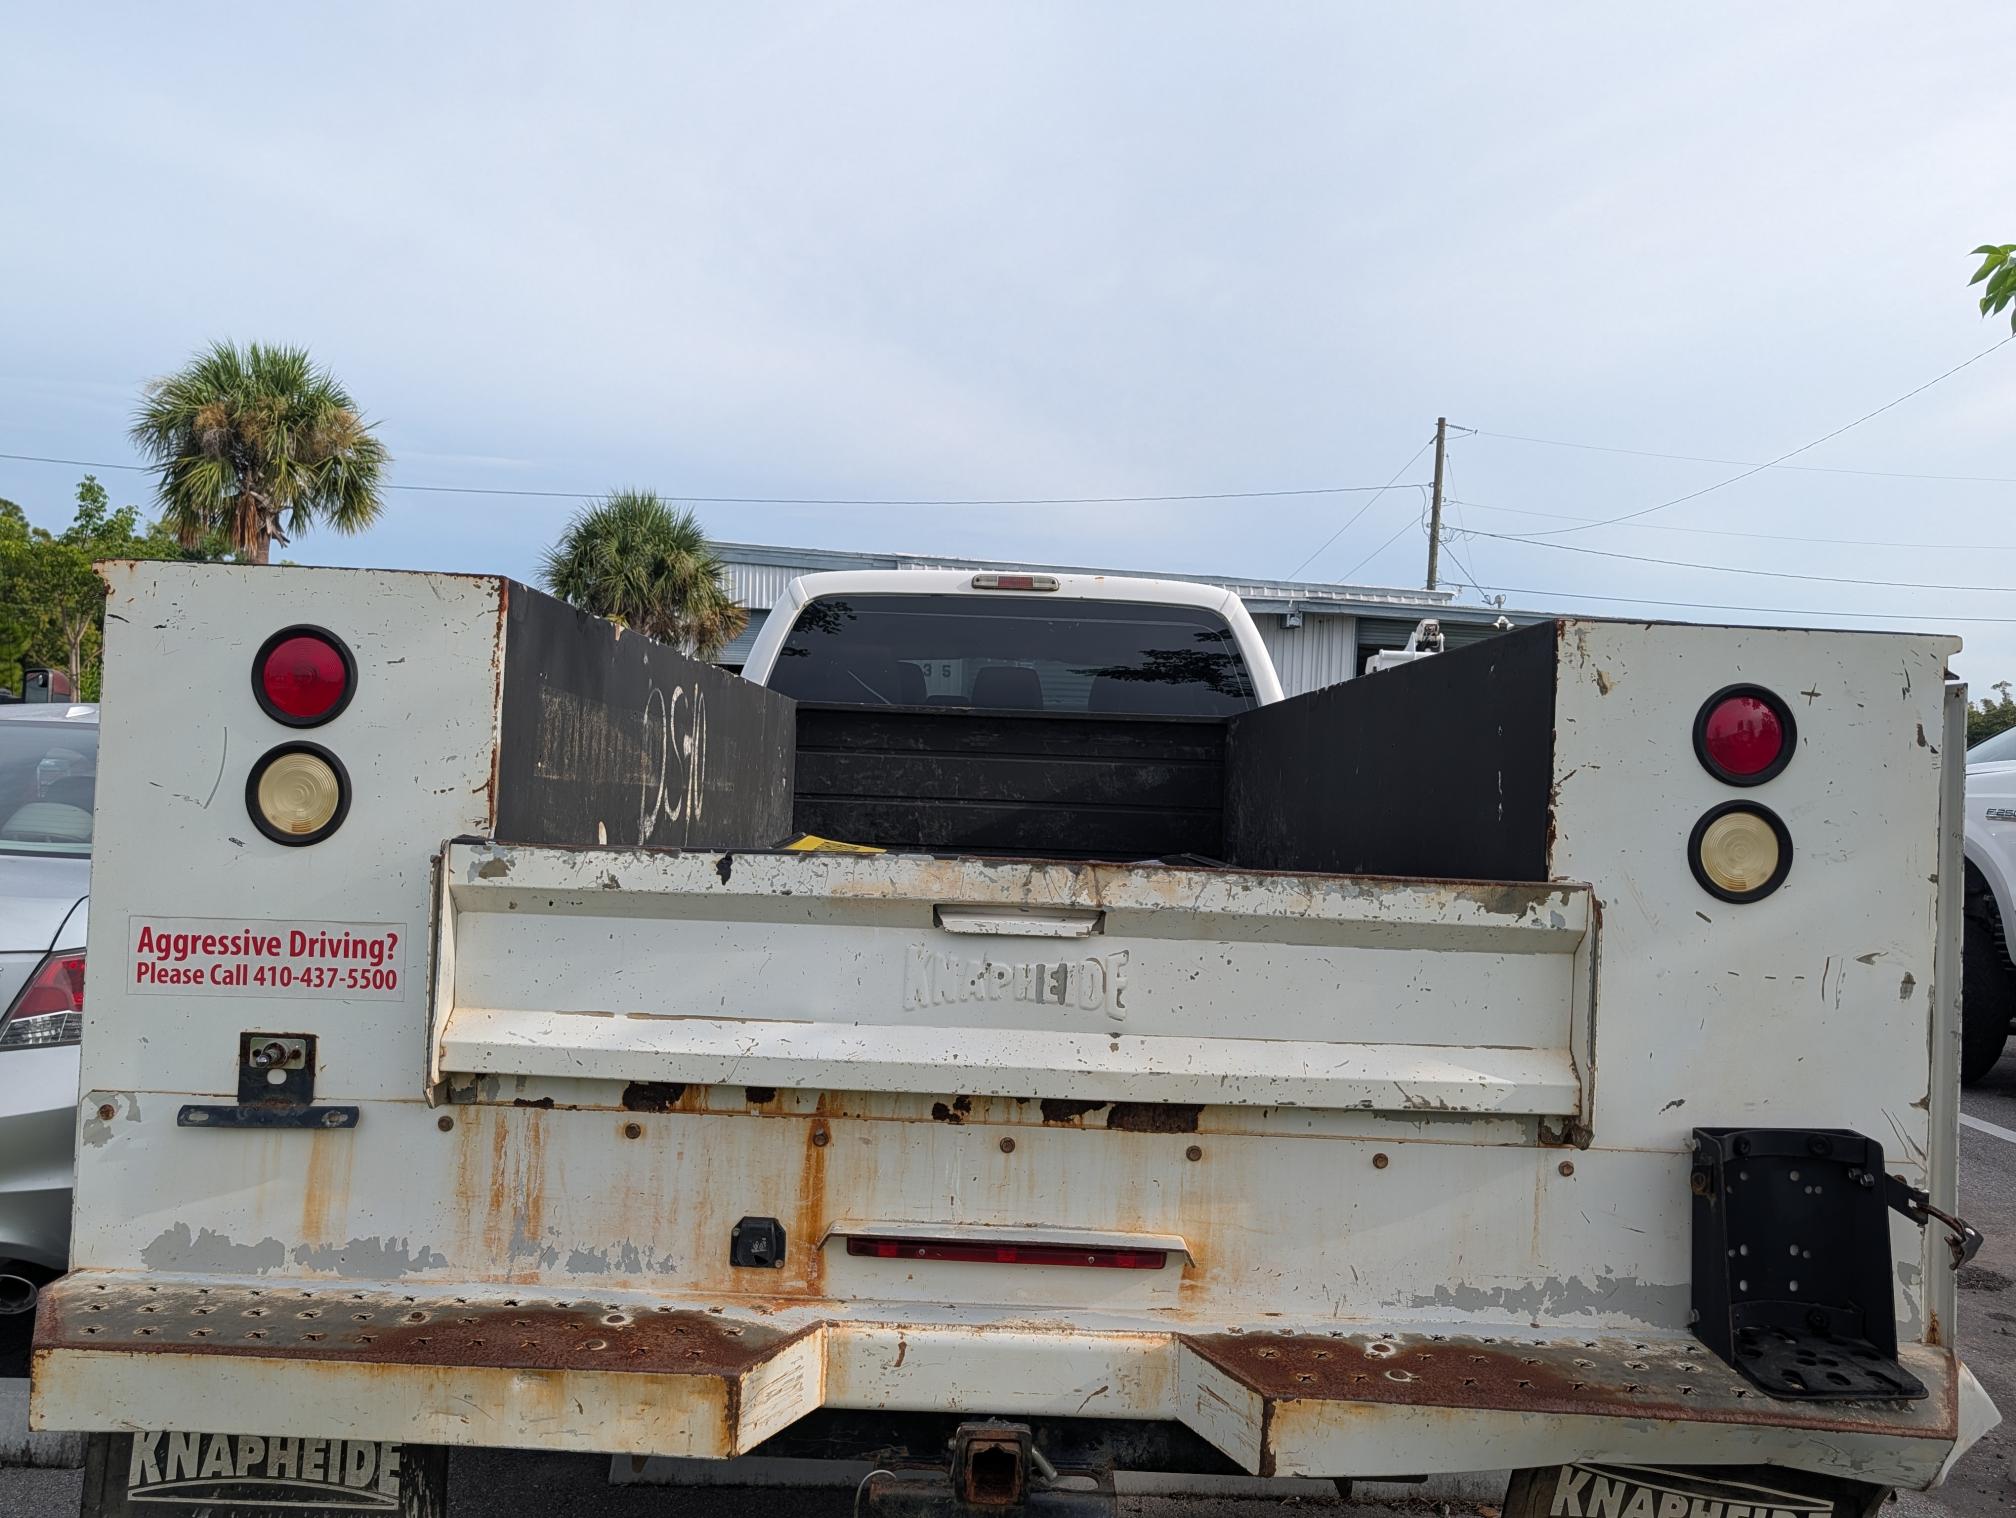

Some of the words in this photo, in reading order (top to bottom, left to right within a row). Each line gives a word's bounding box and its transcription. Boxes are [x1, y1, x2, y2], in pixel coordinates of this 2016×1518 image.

[137, 926, 282, 962] Aggressive
[289, 930, 399, 967] Driving?
[136, 961, 205, 985] Please
[210, 963, 249, 986] Call
[253, 965, 398, 990] 410-437-5500
[128, 1431, 401, 1498] KNAPHEIDE
